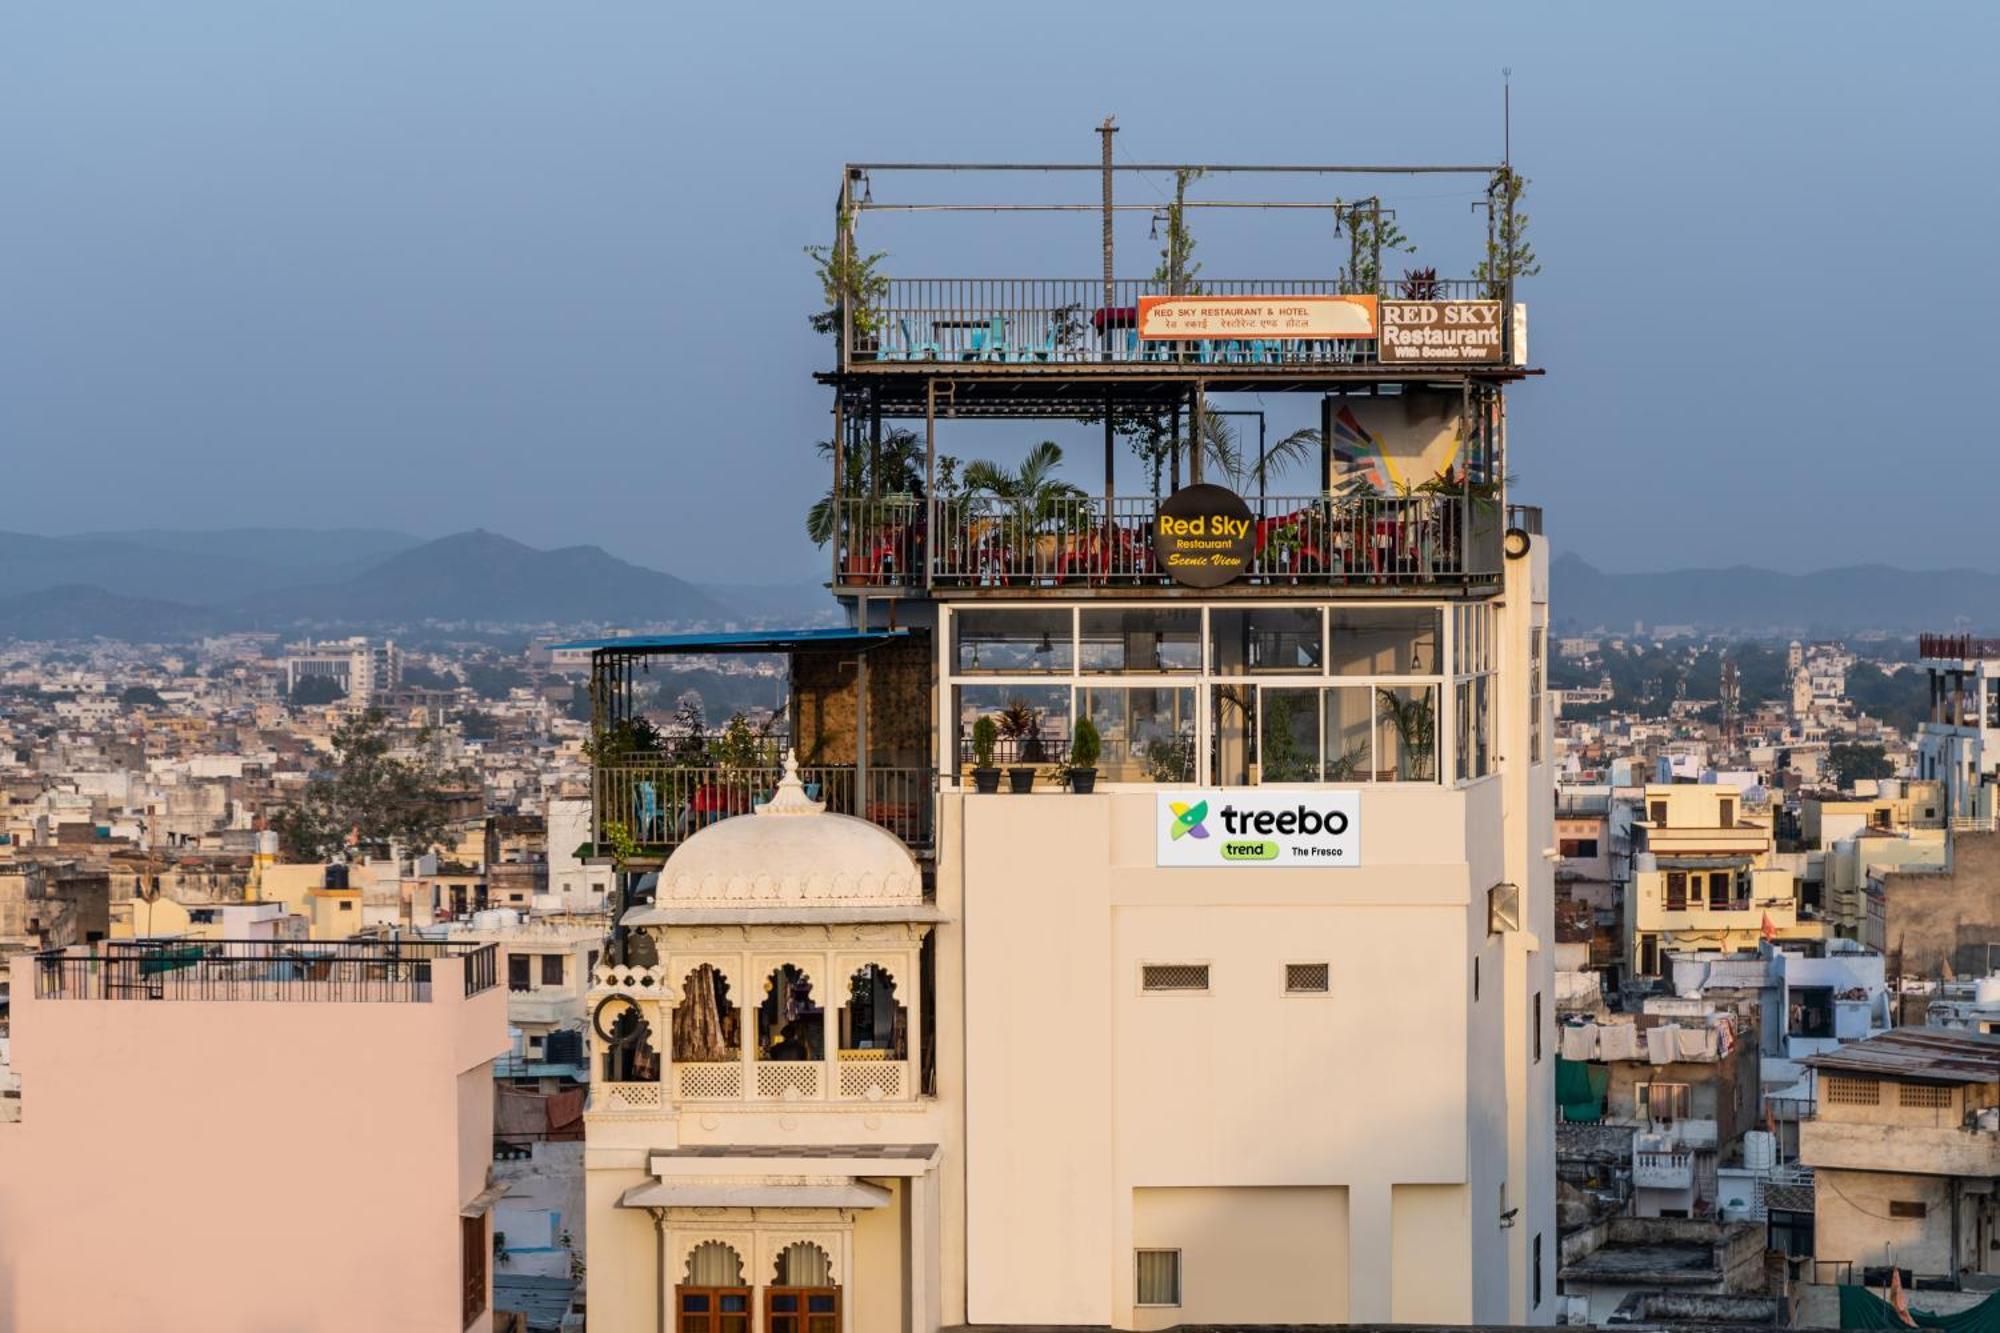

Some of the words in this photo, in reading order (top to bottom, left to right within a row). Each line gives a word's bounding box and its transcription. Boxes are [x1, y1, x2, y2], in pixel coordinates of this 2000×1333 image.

[1154, 309, 1173, 317] RED
[1178, 308, 1197, 317] SKY
[1201, 308, 1262, 317] RESTAURANT
[1267, 308, 1274, 316] &
[1279, 308, 1310, 316] HOTEL
[1382, 306, 1438, 324] RED
[1444, 306, 1499, 324] SKY
[1383, 325, 1499, 345] Restaurant
[1395, 346, 1420, 358] With
[1422, 346, 1459, 358] Scenic
[1460, 346, 1488, 358] View
[1160, 515, 1205, 535] Red
[1211, 515, 1250, 540] Sky
[1176, 539, 1232, 549] Restaurant
[1167, 553, 1208, 566] Scenic
[1211, 553, 1241, 566] View
[1220, 805, 1349, 835] treebo
[1226, 843, 1264, 855] trend
[1292, 847, 1309, 856] The
[1311, 847, 1343, 856] Fresco
